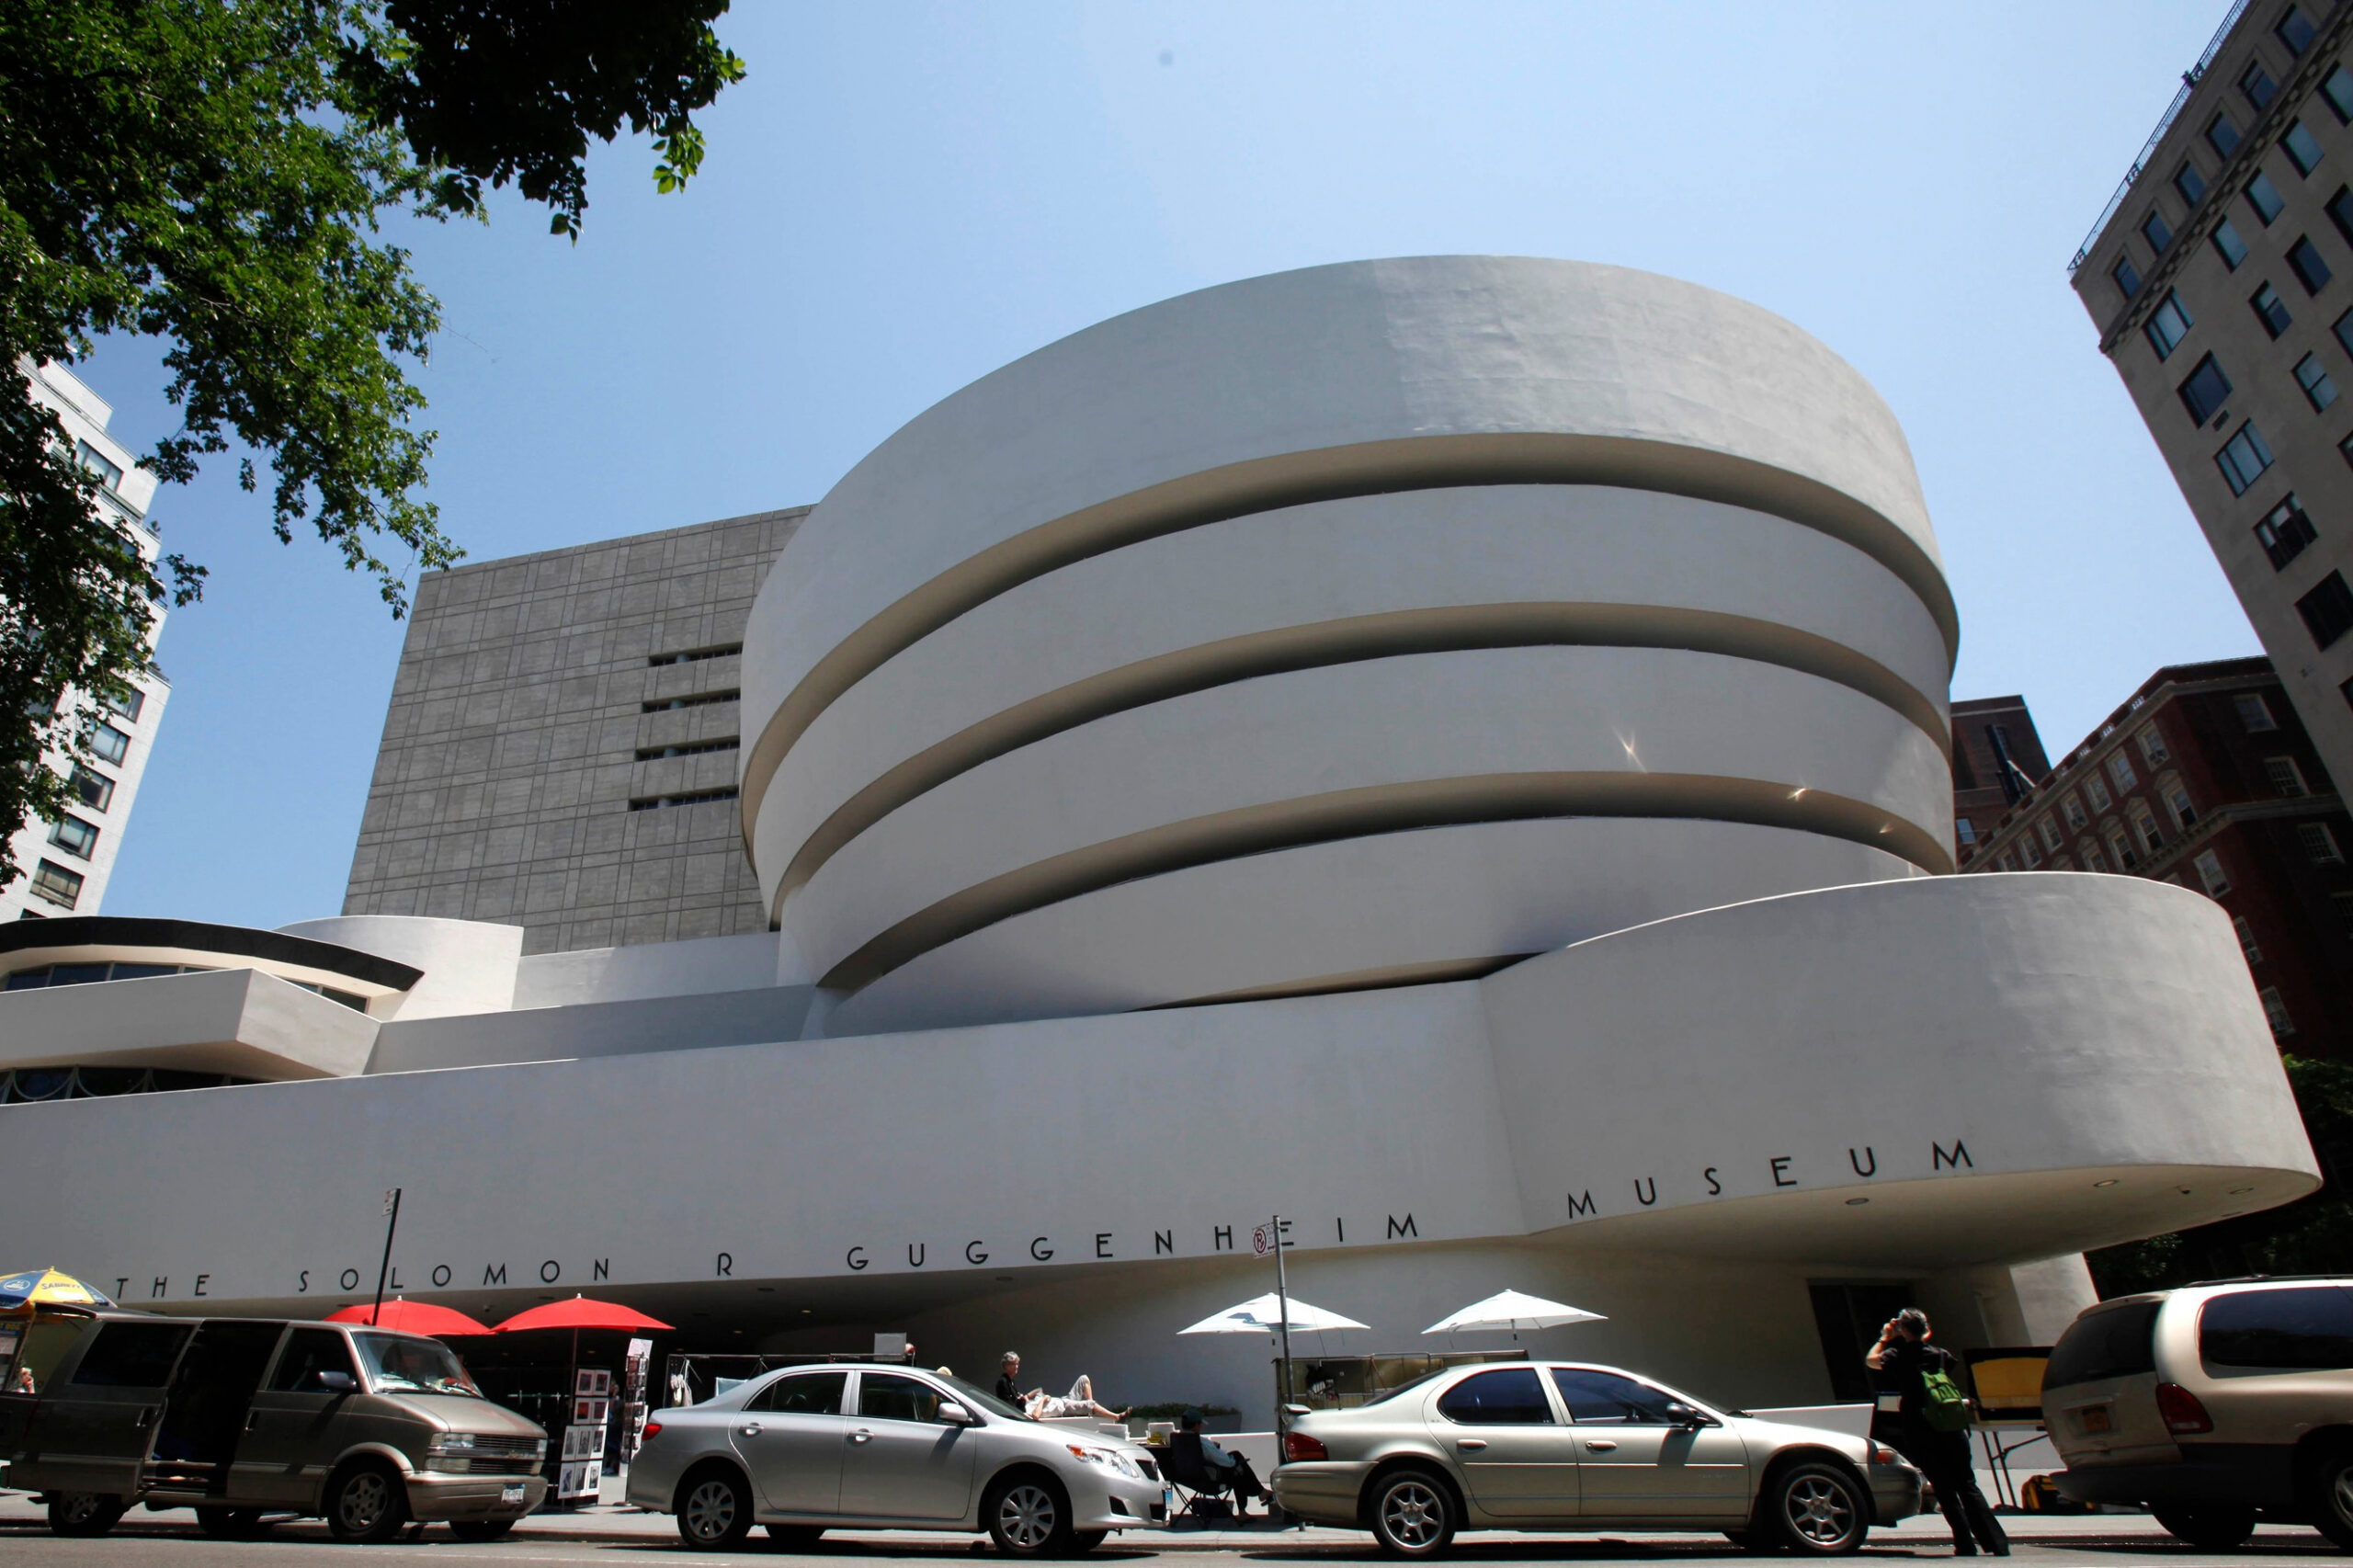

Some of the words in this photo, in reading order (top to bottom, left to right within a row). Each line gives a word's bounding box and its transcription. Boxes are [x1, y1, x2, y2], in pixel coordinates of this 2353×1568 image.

[116, 1274, 210, 1301] THE
[299, 1258, 609, 1293] SOLOMON
[717, 1253, 733, 1277] R
[847, 1212, 1419, 1271] GUGGENHEIM
[1568, 1139, 1974, 1220] MUSEUM
